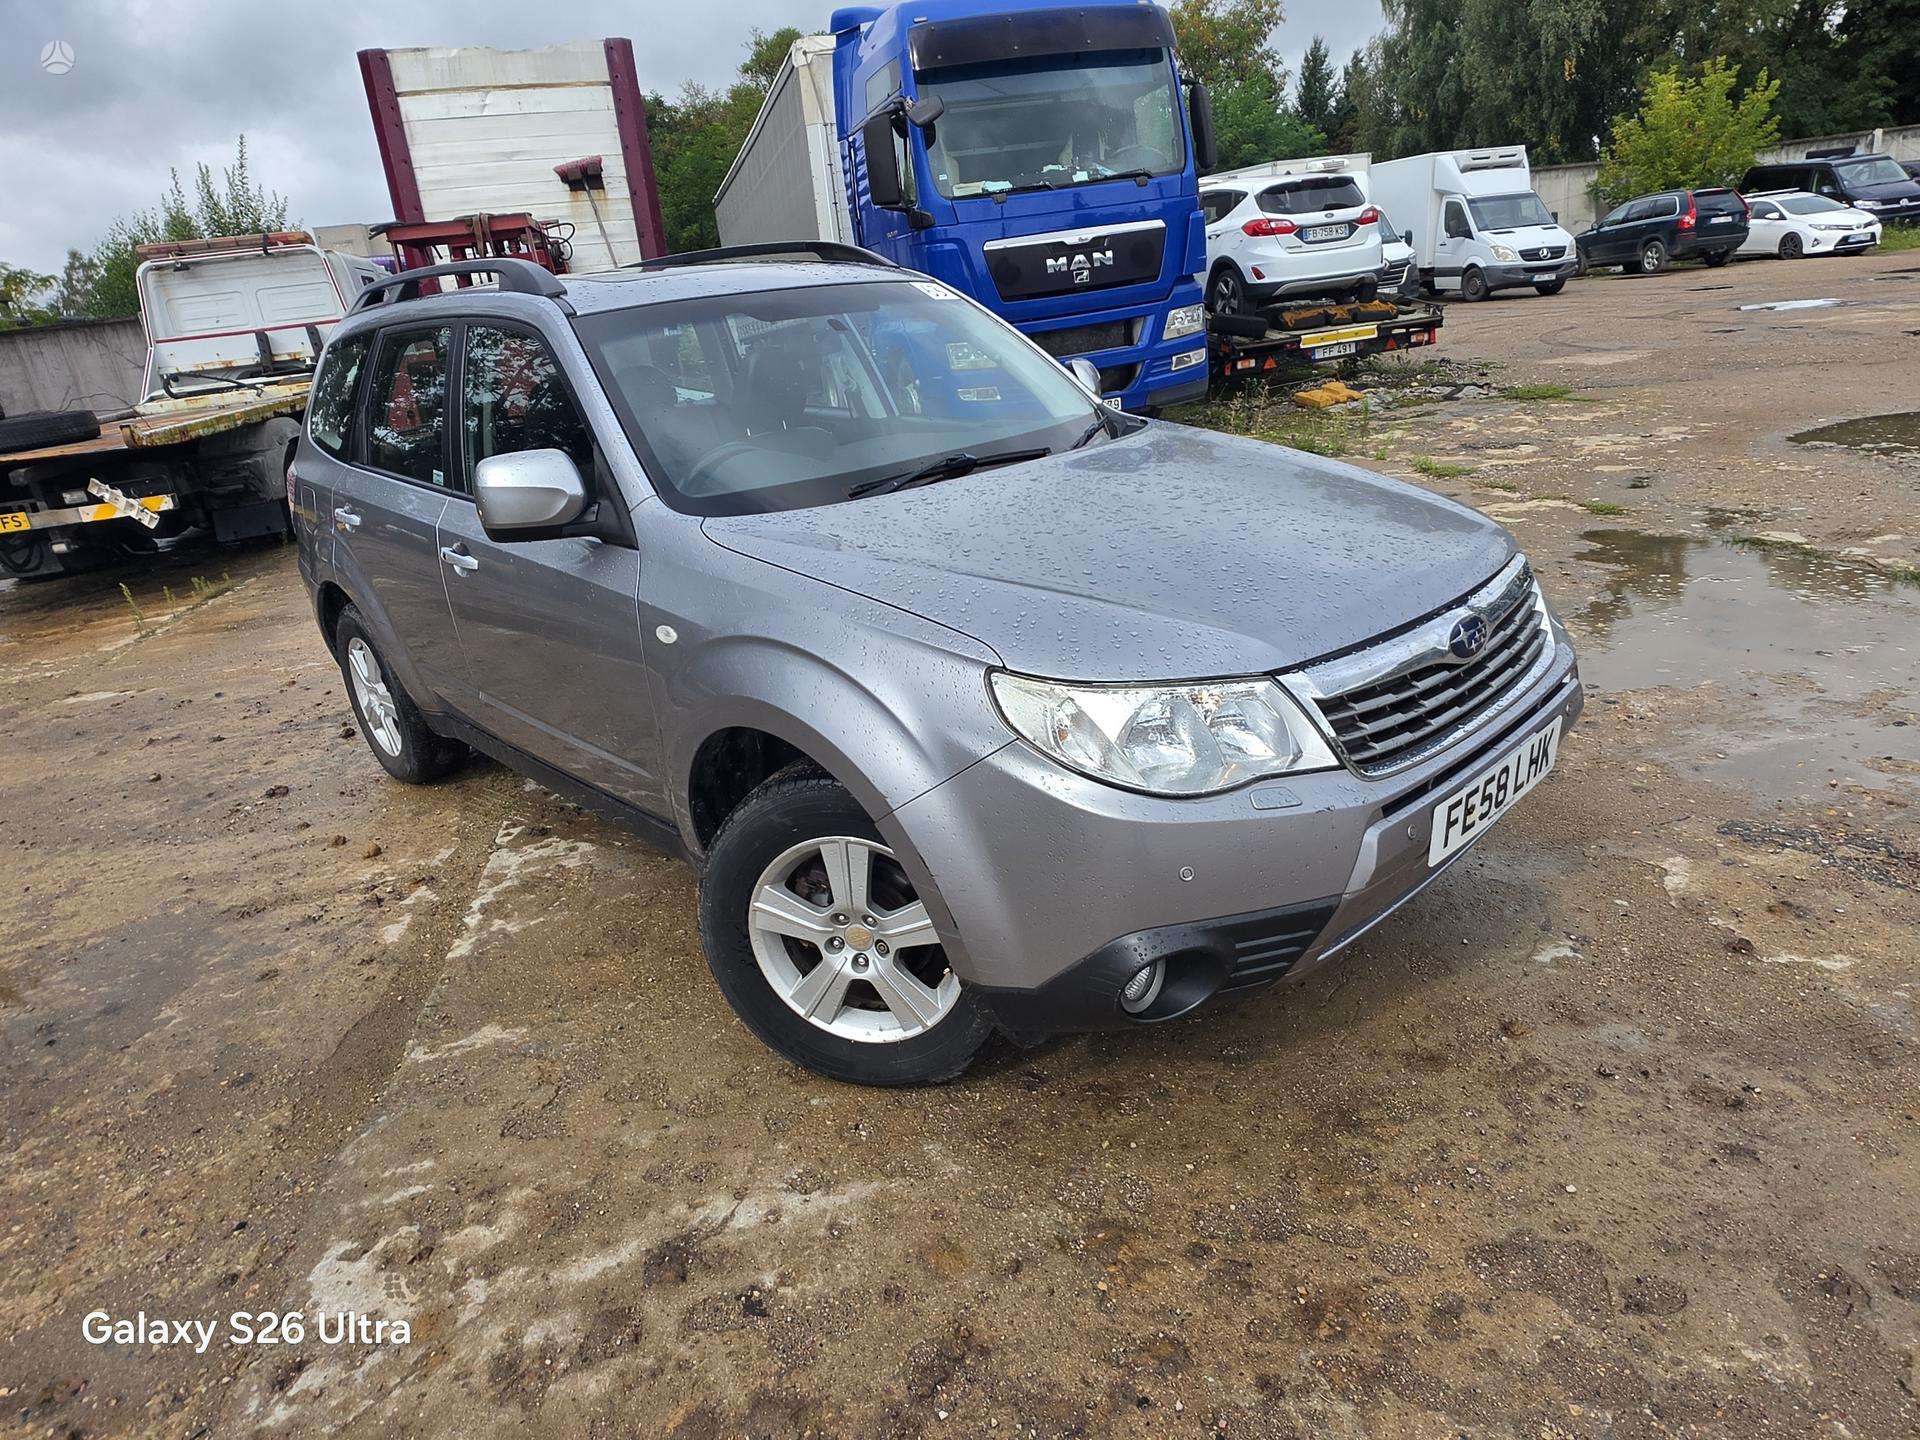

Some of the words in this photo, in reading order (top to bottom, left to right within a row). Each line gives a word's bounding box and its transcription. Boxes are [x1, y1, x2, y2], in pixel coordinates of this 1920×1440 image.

[1045, 249, 1113, 273] MAN
[1322, 347, 1334, 357] FF
[0, 515, 22, 529] FS
[1443, 765, 1510, 849] FE58
[1513, 728, 1554, 795] LHK
